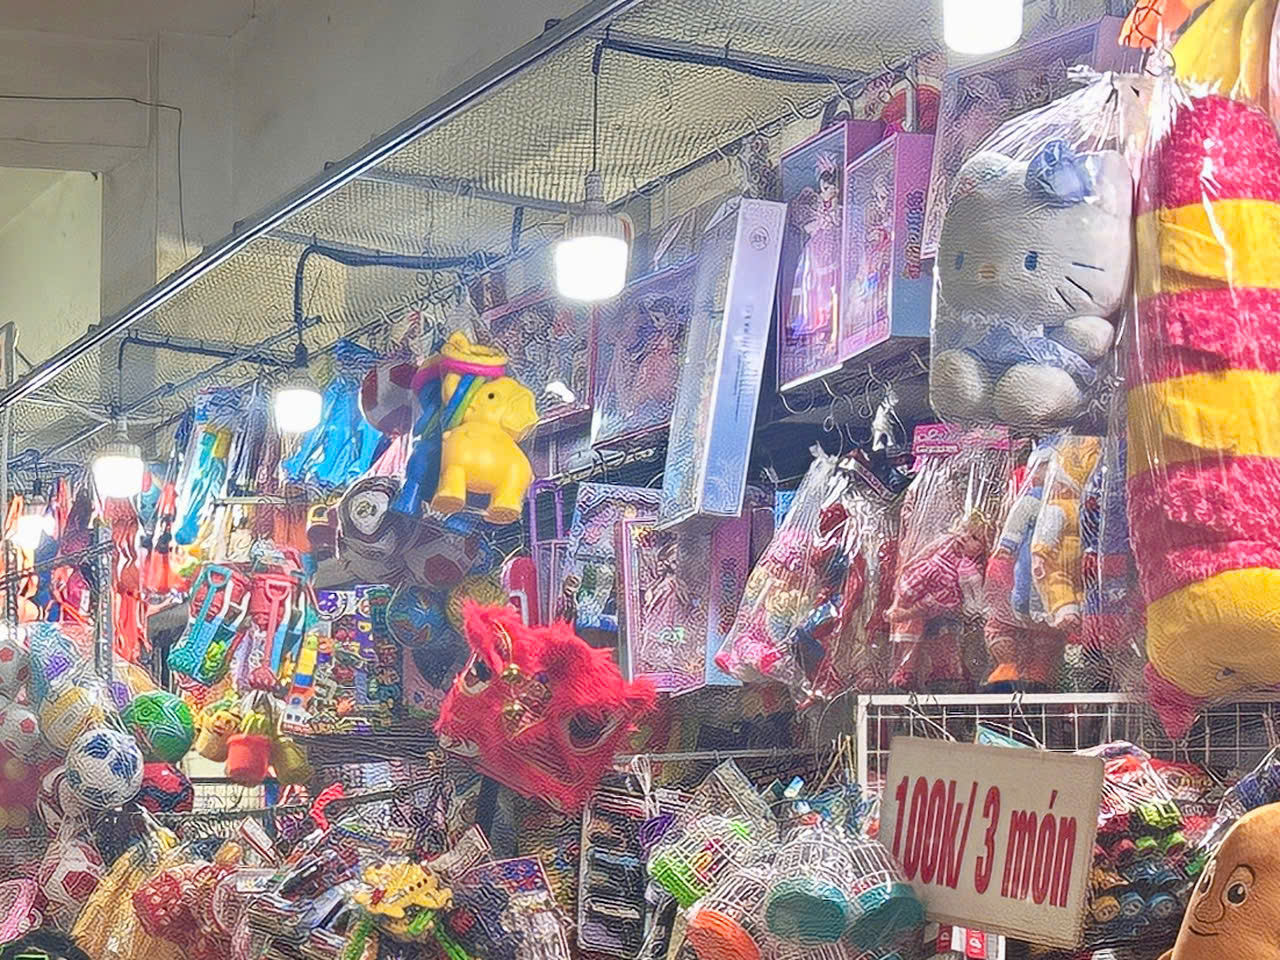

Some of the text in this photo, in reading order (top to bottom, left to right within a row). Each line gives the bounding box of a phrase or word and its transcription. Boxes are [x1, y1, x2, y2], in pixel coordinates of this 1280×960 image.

[891, 775, 1078, 908] 100k/ 3 món
